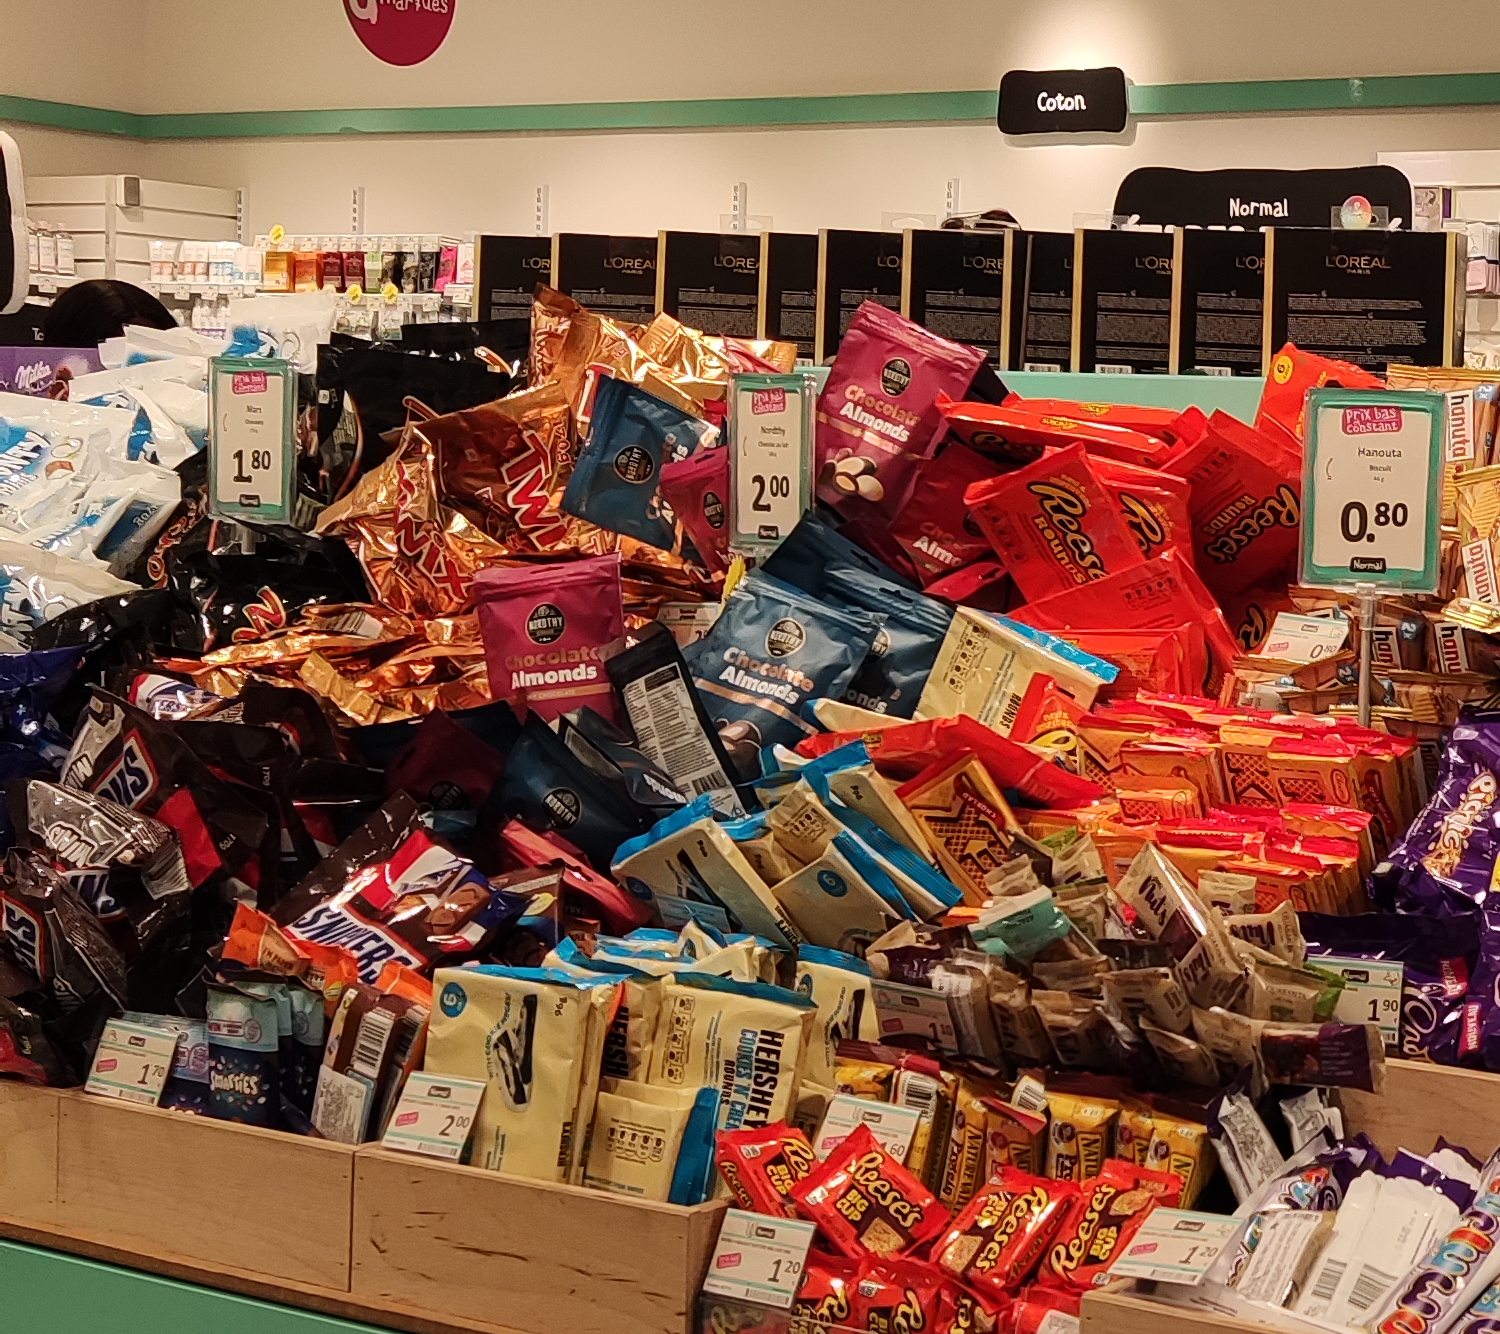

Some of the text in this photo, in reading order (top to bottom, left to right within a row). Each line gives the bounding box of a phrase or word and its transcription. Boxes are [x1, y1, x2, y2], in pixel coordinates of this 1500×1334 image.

[1036, 91, 1087, 112] Coton
[1229, 197, 1290, 219] Normal
[838, 401, 911, 443] Almonds
[1450, 394, 1470, 459] hanuta
[501, 429, 568, 552] TWI
[1340, 501, 1409, 543] 0.80
[511, 663, 598, 691] Almonds
[719, 665, 800, 705] Almonds
[835, 1197, 864, 1223] CUP
[845, 1188, 870, 1213] BIG
[850, 1151, 924, 1229] Reese's
[975, 1185, 1050, 1274] Reese's
[1050, 1183, 1118, 1283] Reese's
[1099, 1225, 1120, 1262] CUP
